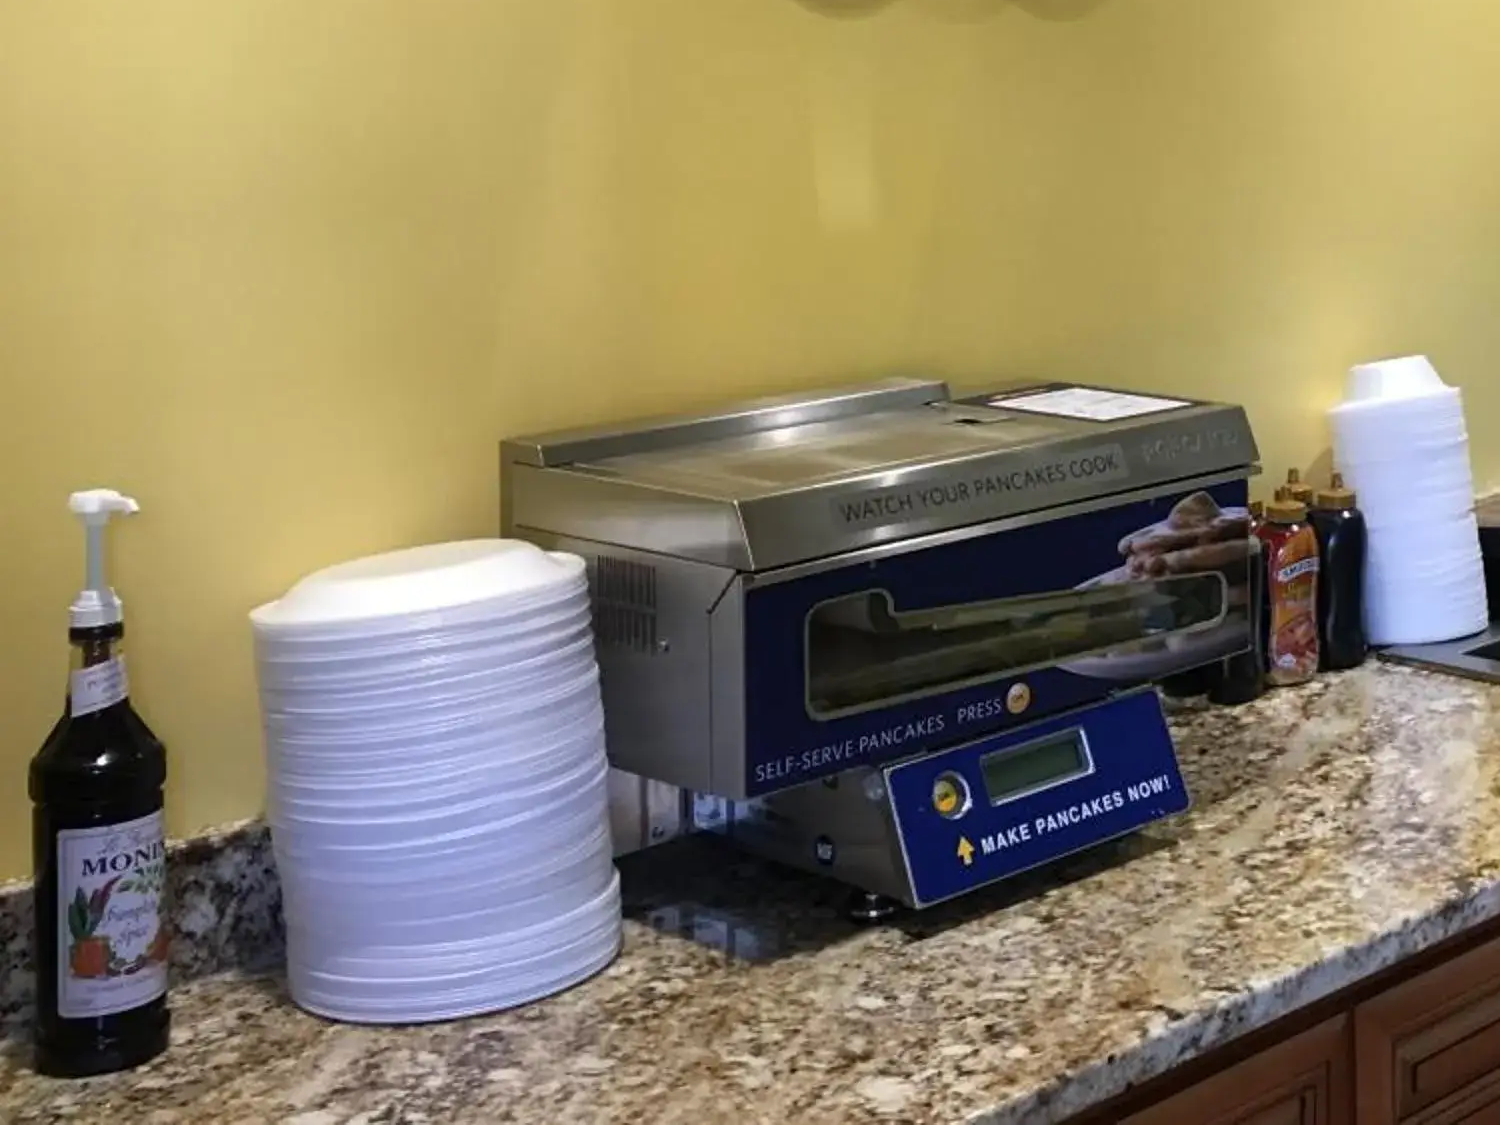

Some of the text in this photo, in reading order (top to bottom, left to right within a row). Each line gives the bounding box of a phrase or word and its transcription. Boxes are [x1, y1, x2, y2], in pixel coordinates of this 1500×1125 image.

[840, 453, 1119, 523] WATCH YOUR PANCAKES COOK
[754, 698, 1001, 782] SELF-SERVE PANCAKES PRESS
[980, 774, 1171, 856] MAKE PANCAKES NOW!
